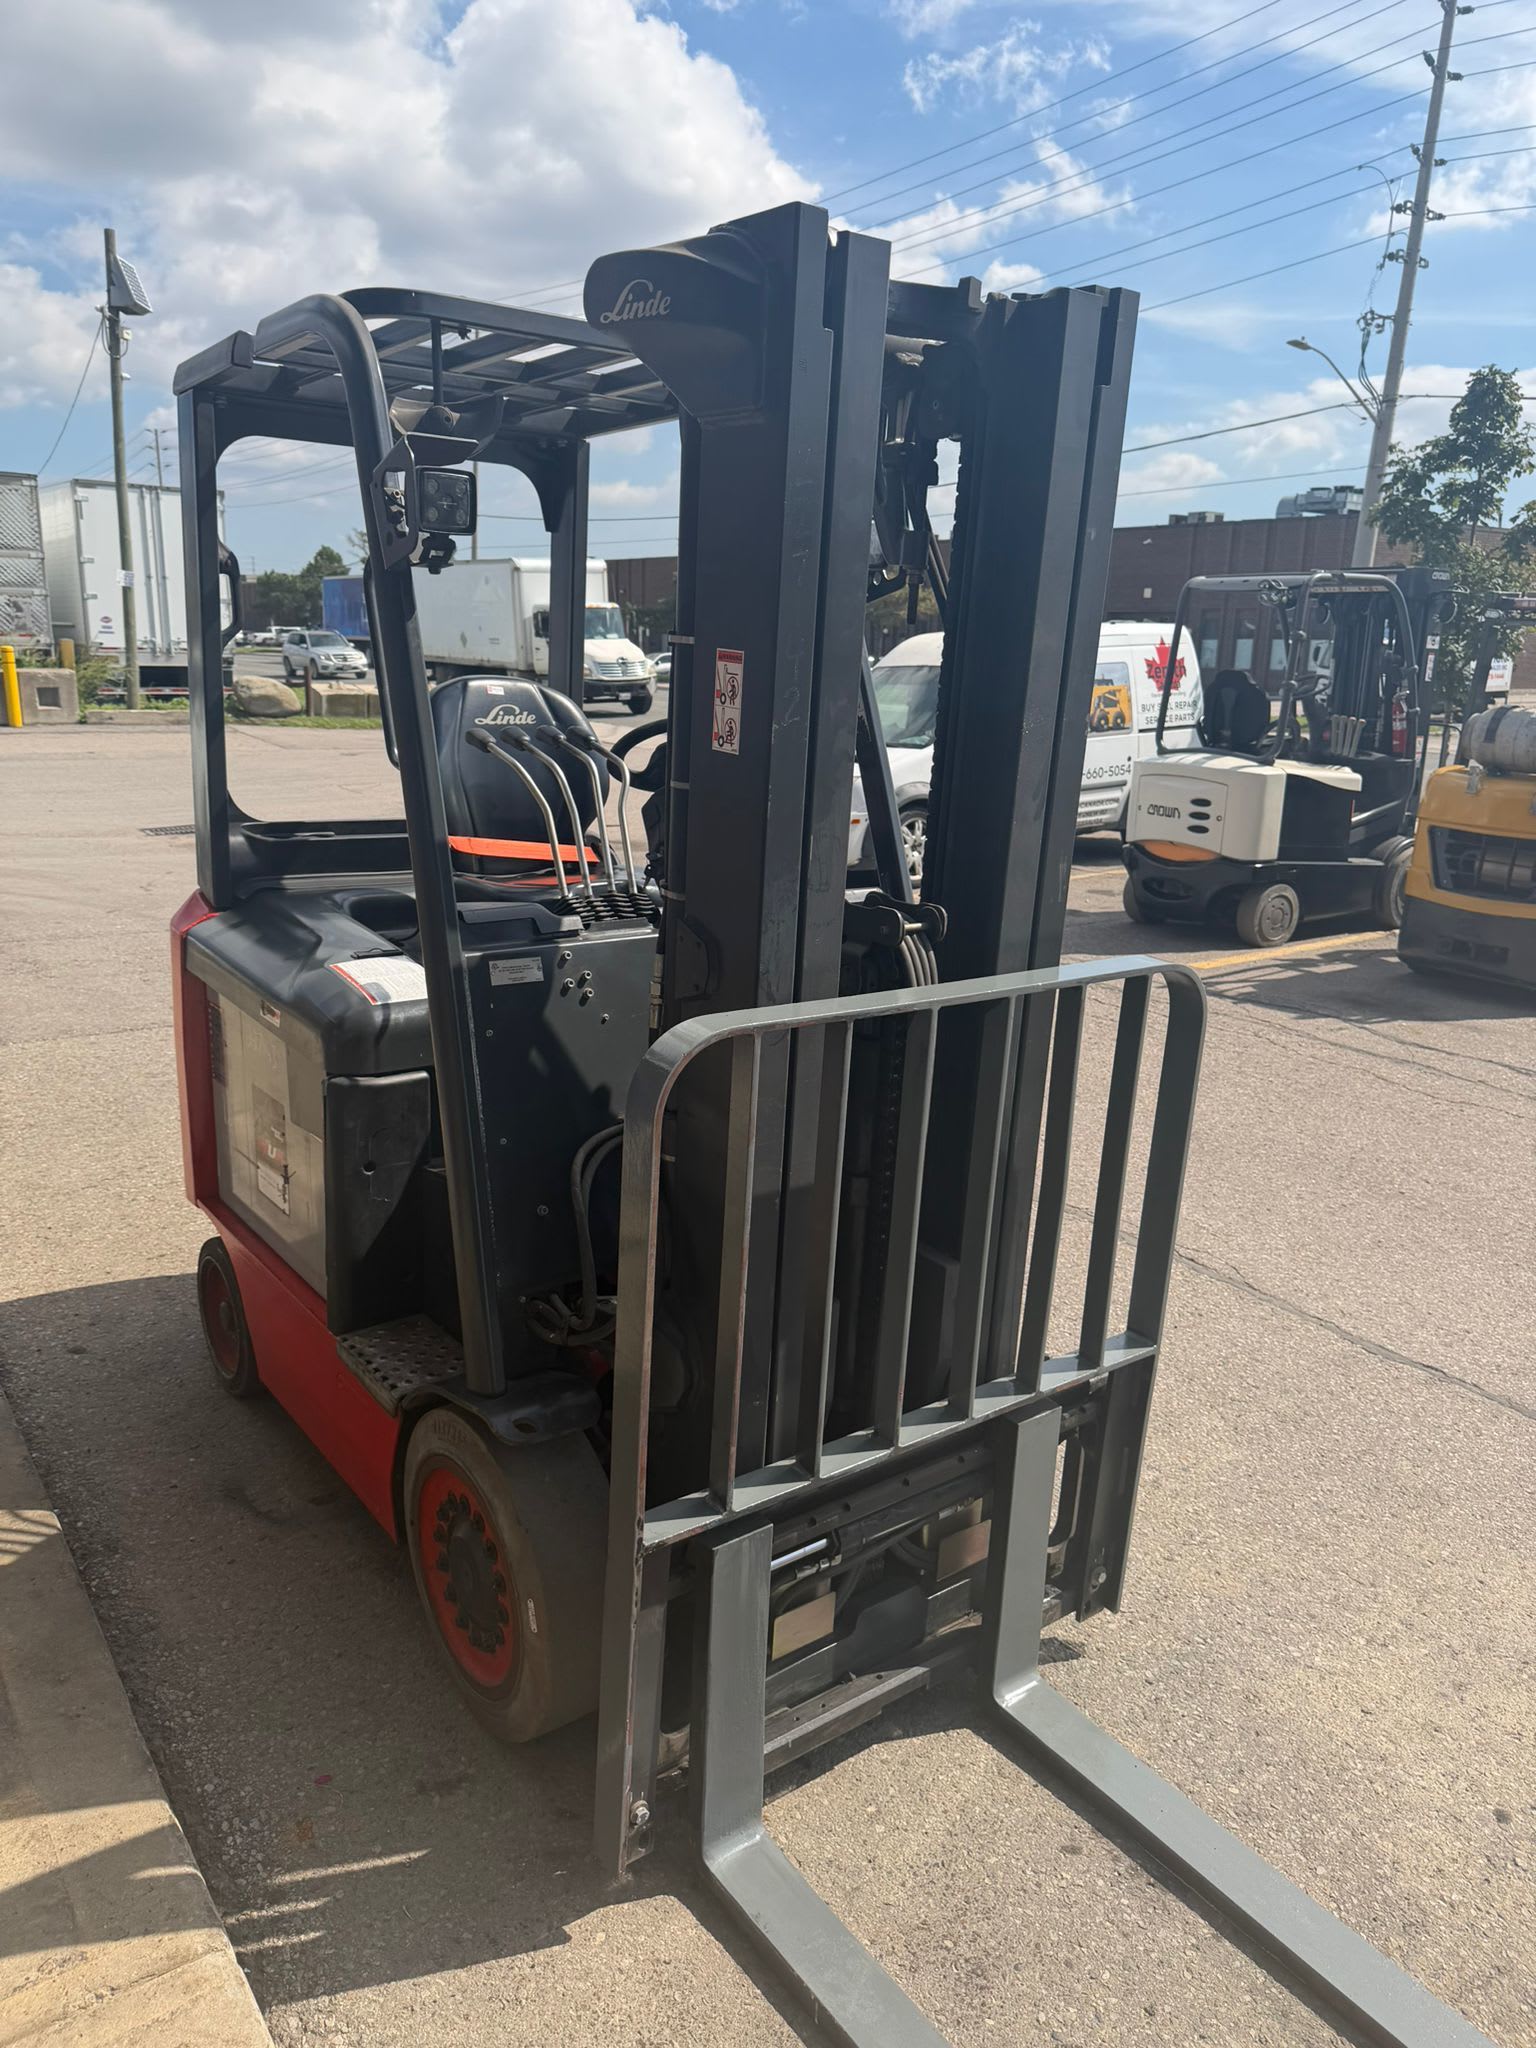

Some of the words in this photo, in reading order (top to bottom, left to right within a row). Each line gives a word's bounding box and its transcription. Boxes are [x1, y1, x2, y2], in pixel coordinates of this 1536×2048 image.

[600, 279, 671, 324] Linde
[474, 704, 537, 725] Linde
[1141, 703, 1155, 713] BUY
[1175, 700, 1198, 710] REPAIR
[1145, 714, 1173, 725] SERCE
[1175, 713, 1195, 723] PARTS
[1147, 803, 1181, 819] CROWN
